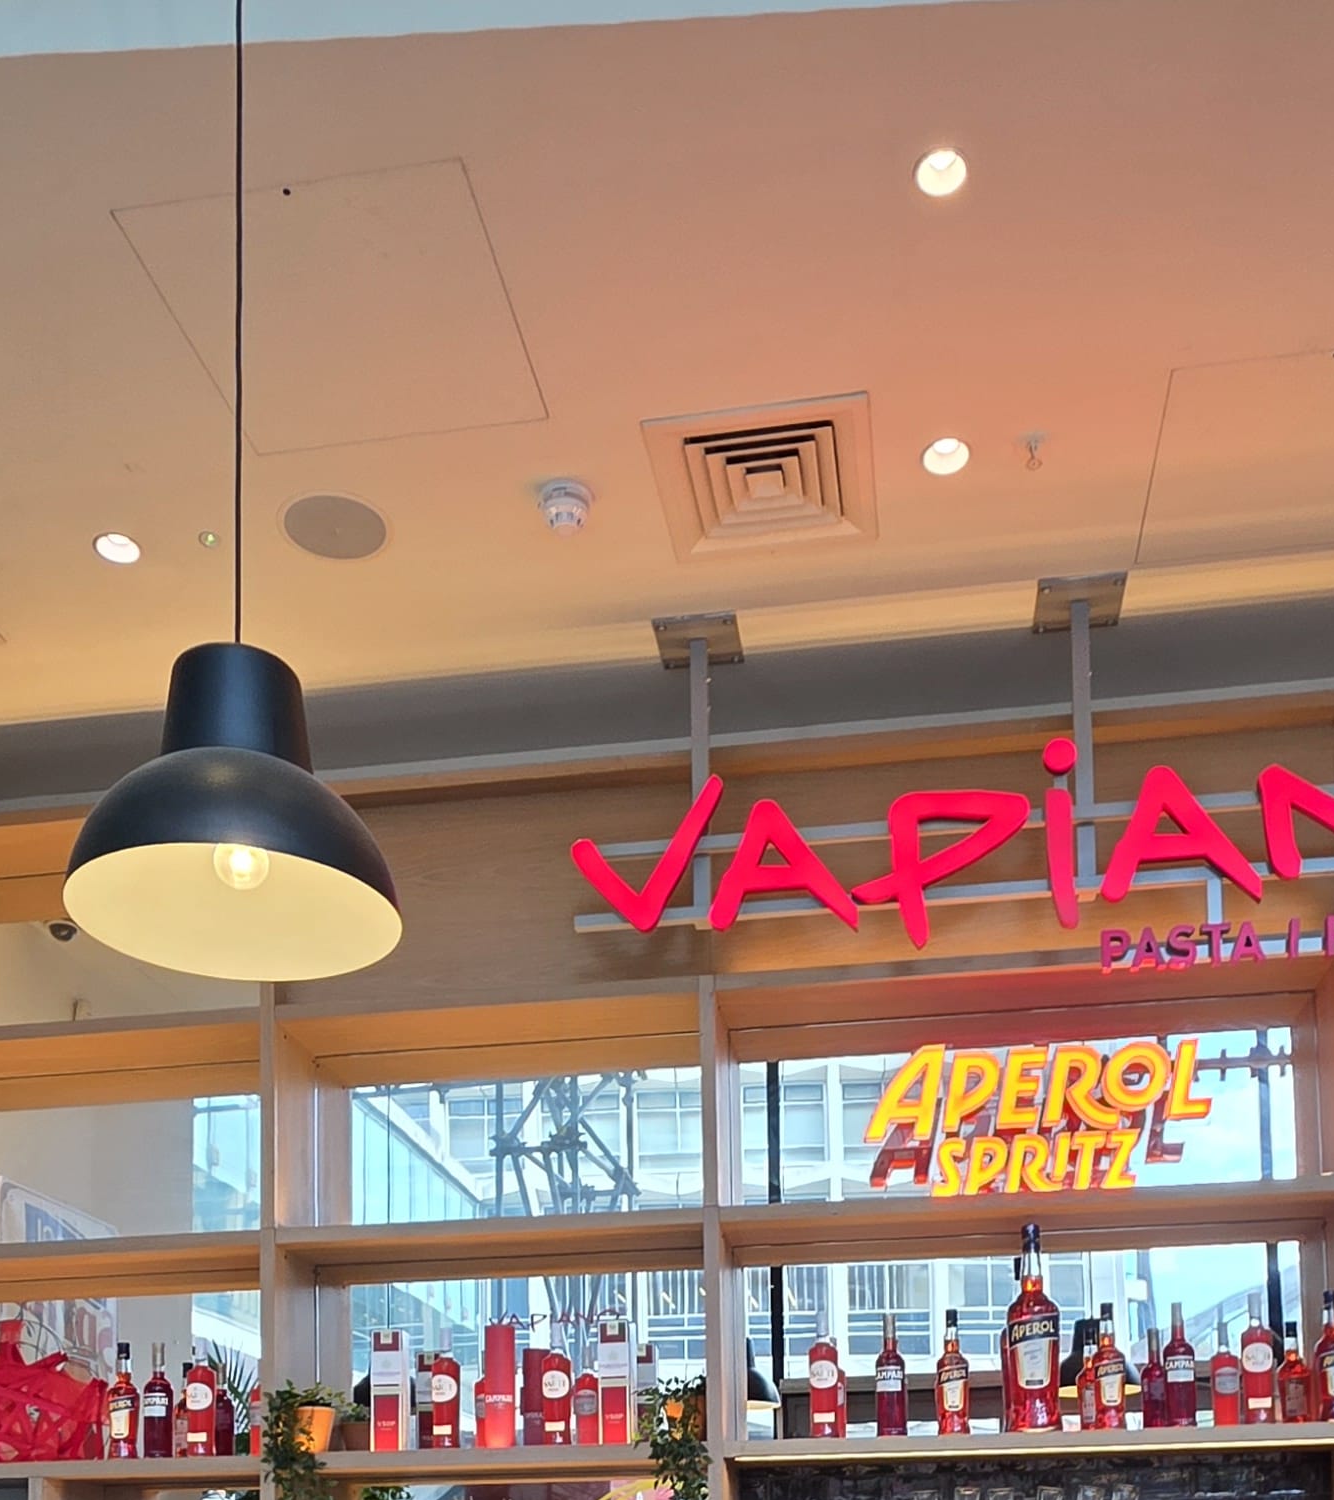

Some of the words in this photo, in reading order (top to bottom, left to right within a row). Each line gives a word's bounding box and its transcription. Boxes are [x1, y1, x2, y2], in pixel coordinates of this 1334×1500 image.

[1100, 921, 1266, 973] PASTA
[864, 1038, 1212, 1143] APEROL
[931, 1128, 1140, 1197] SPRITZ
[1011, 1320, 1056, 1343] APEROL
